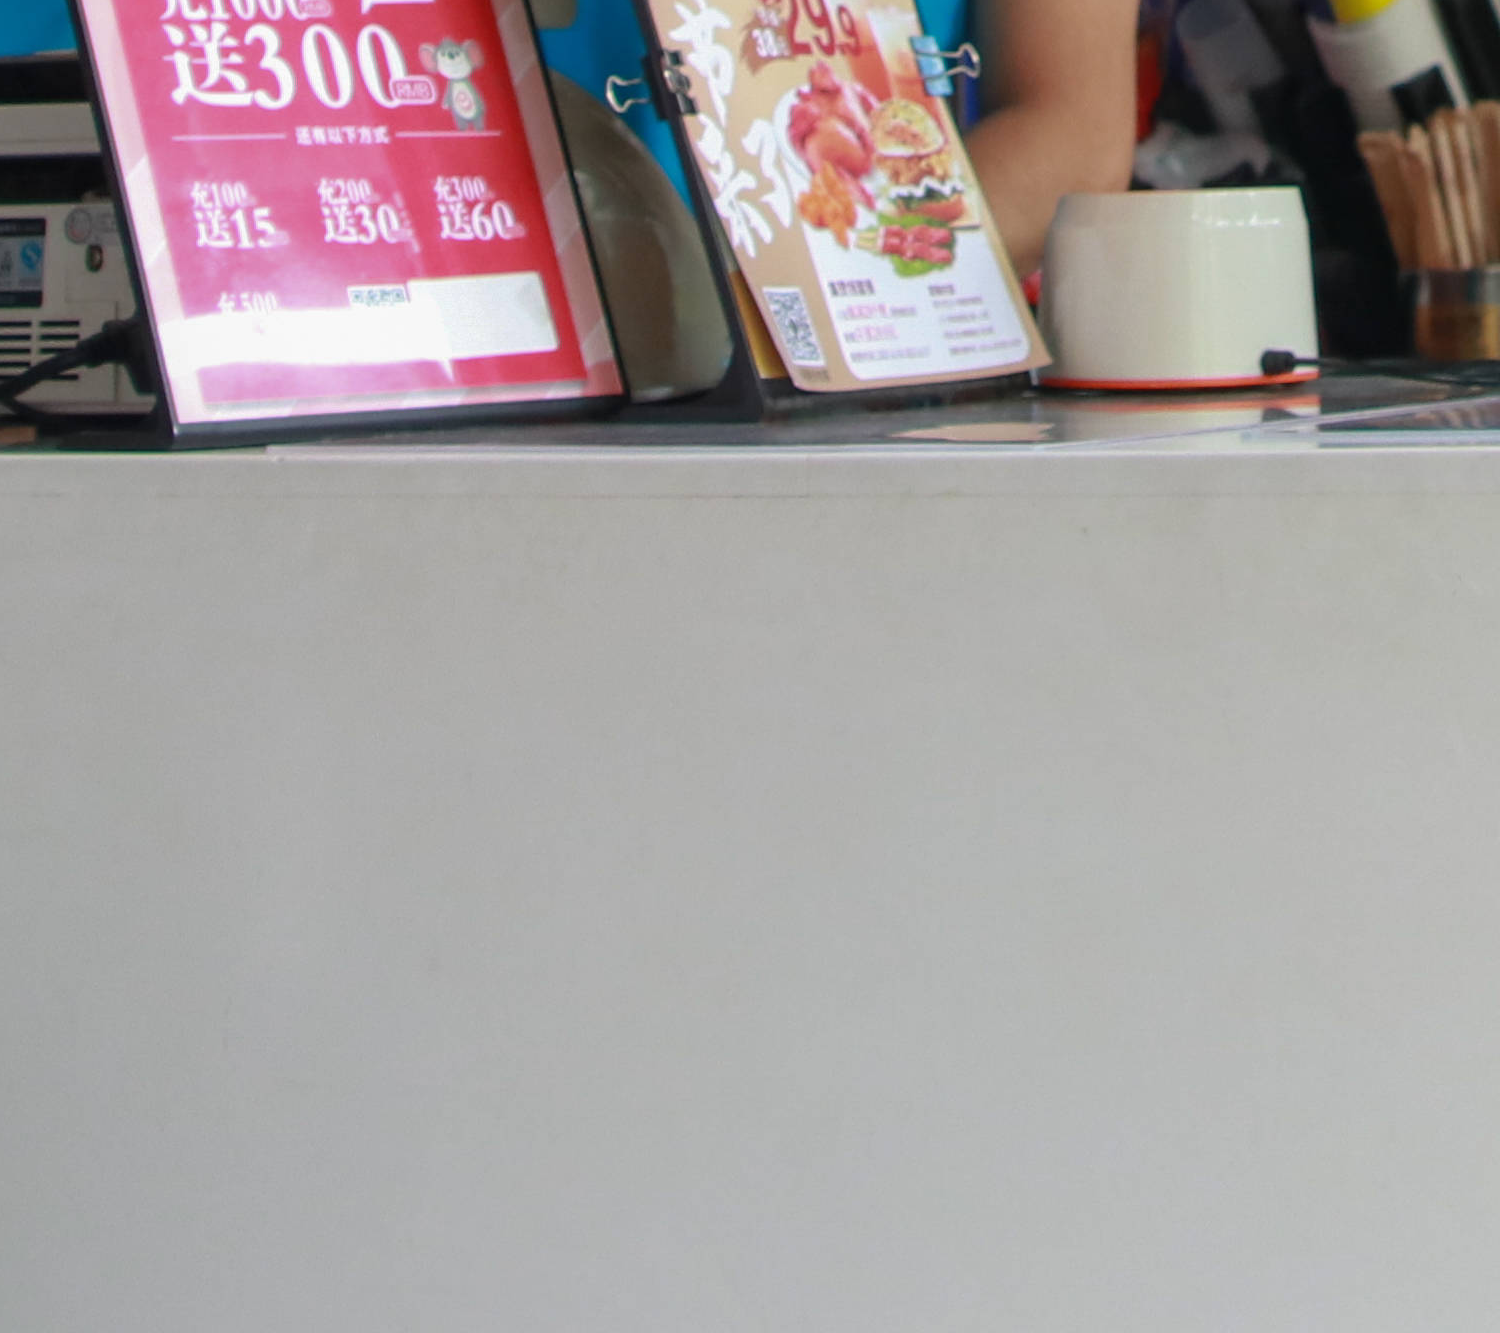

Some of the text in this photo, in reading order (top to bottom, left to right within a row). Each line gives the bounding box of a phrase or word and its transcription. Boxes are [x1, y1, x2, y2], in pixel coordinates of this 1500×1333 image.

[161, 22, 409, 110] 送300
[193, 207, 276, 250] 送15
[321, 203, 401, 245] 送30
[437, 200, 515, 241] 送60
